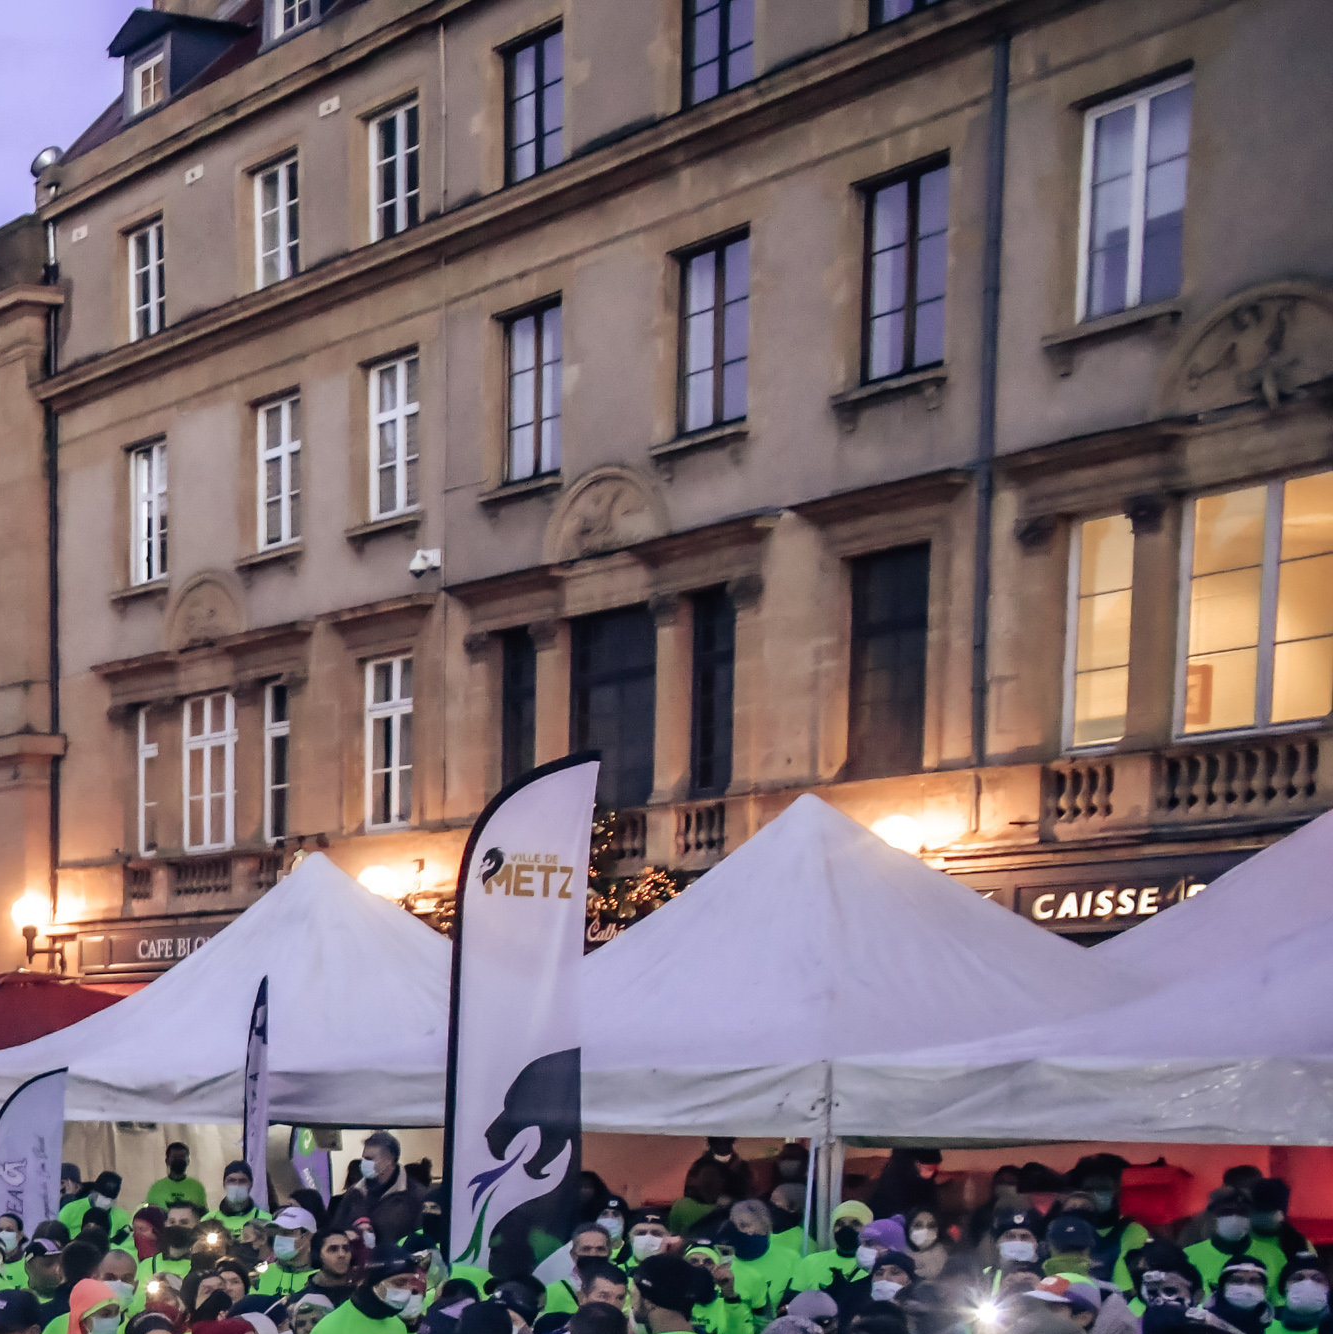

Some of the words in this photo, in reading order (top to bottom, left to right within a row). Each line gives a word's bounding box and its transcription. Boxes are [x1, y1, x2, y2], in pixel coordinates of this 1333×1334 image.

[511, 854, 540, 864] VILLE
[545, 855, 558, 864] DE
[485, 864, 574, 899] METZ
[1033, 888, 1159, 921] CAISSE
[138, 938, 174, 959] CAFE
